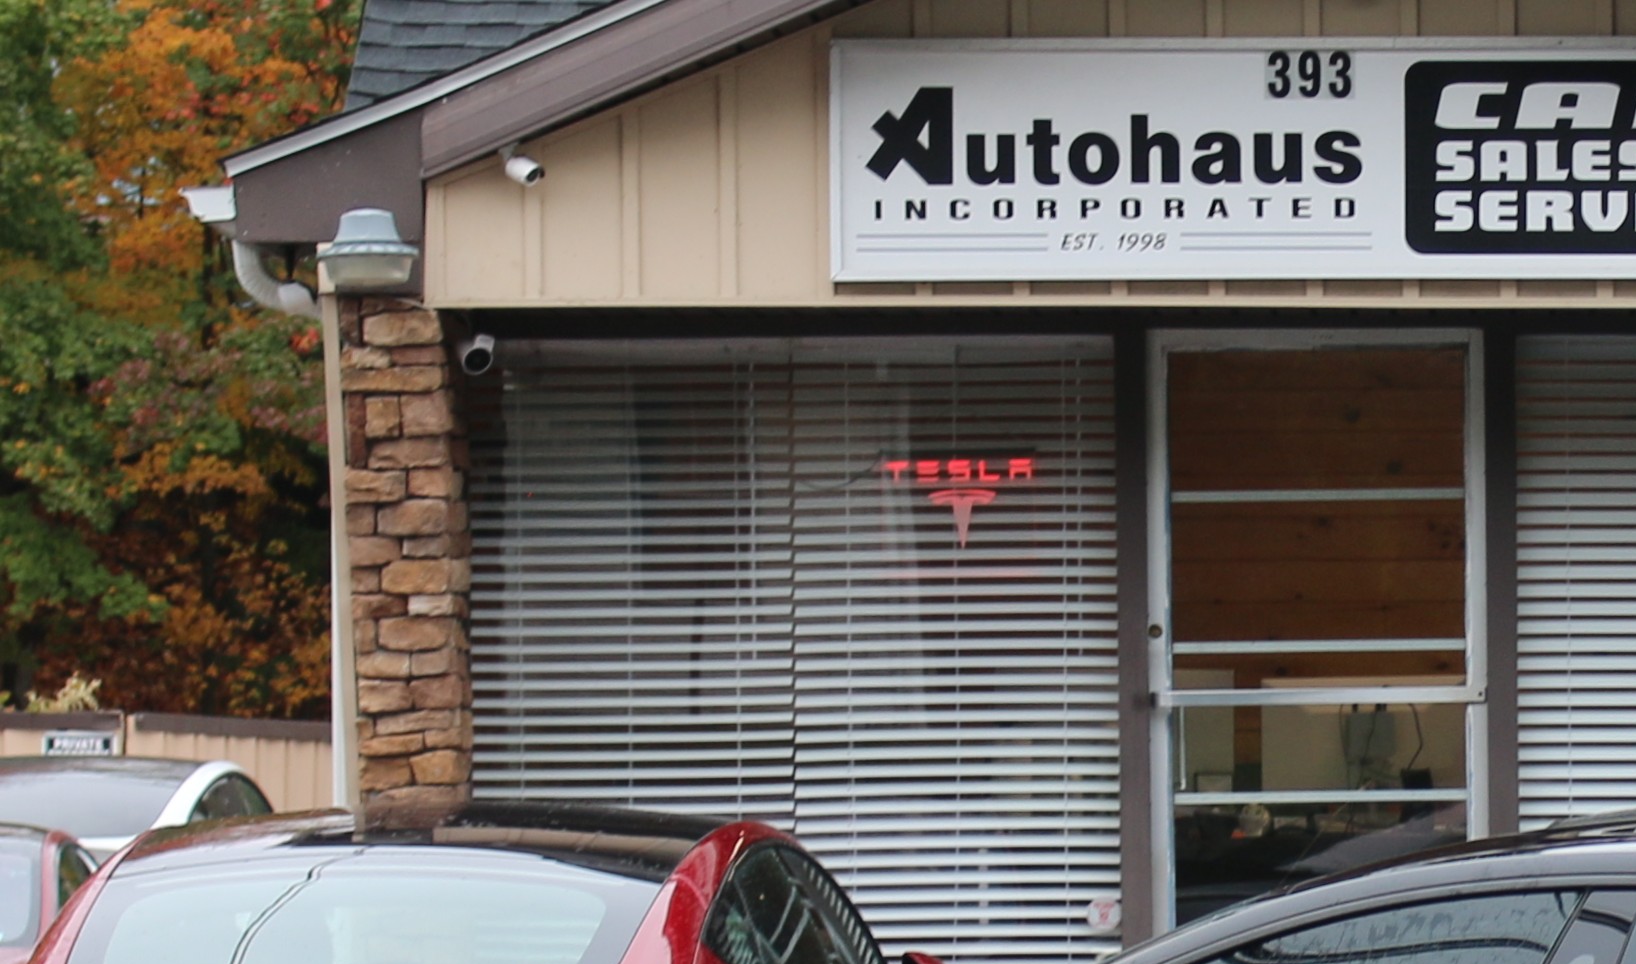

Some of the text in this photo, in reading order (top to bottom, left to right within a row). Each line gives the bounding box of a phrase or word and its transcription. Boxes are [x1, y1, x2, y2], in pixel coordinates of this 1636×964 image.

[1266, 51, 1353, 97] 393
[866, 86, 1363, 186] Autohaus
[874, 198, 1356, 220] INCORPORATED
[1060, 232, 1168, 252] EST. 1998
[885, 458, 1034, 483] TESLA
